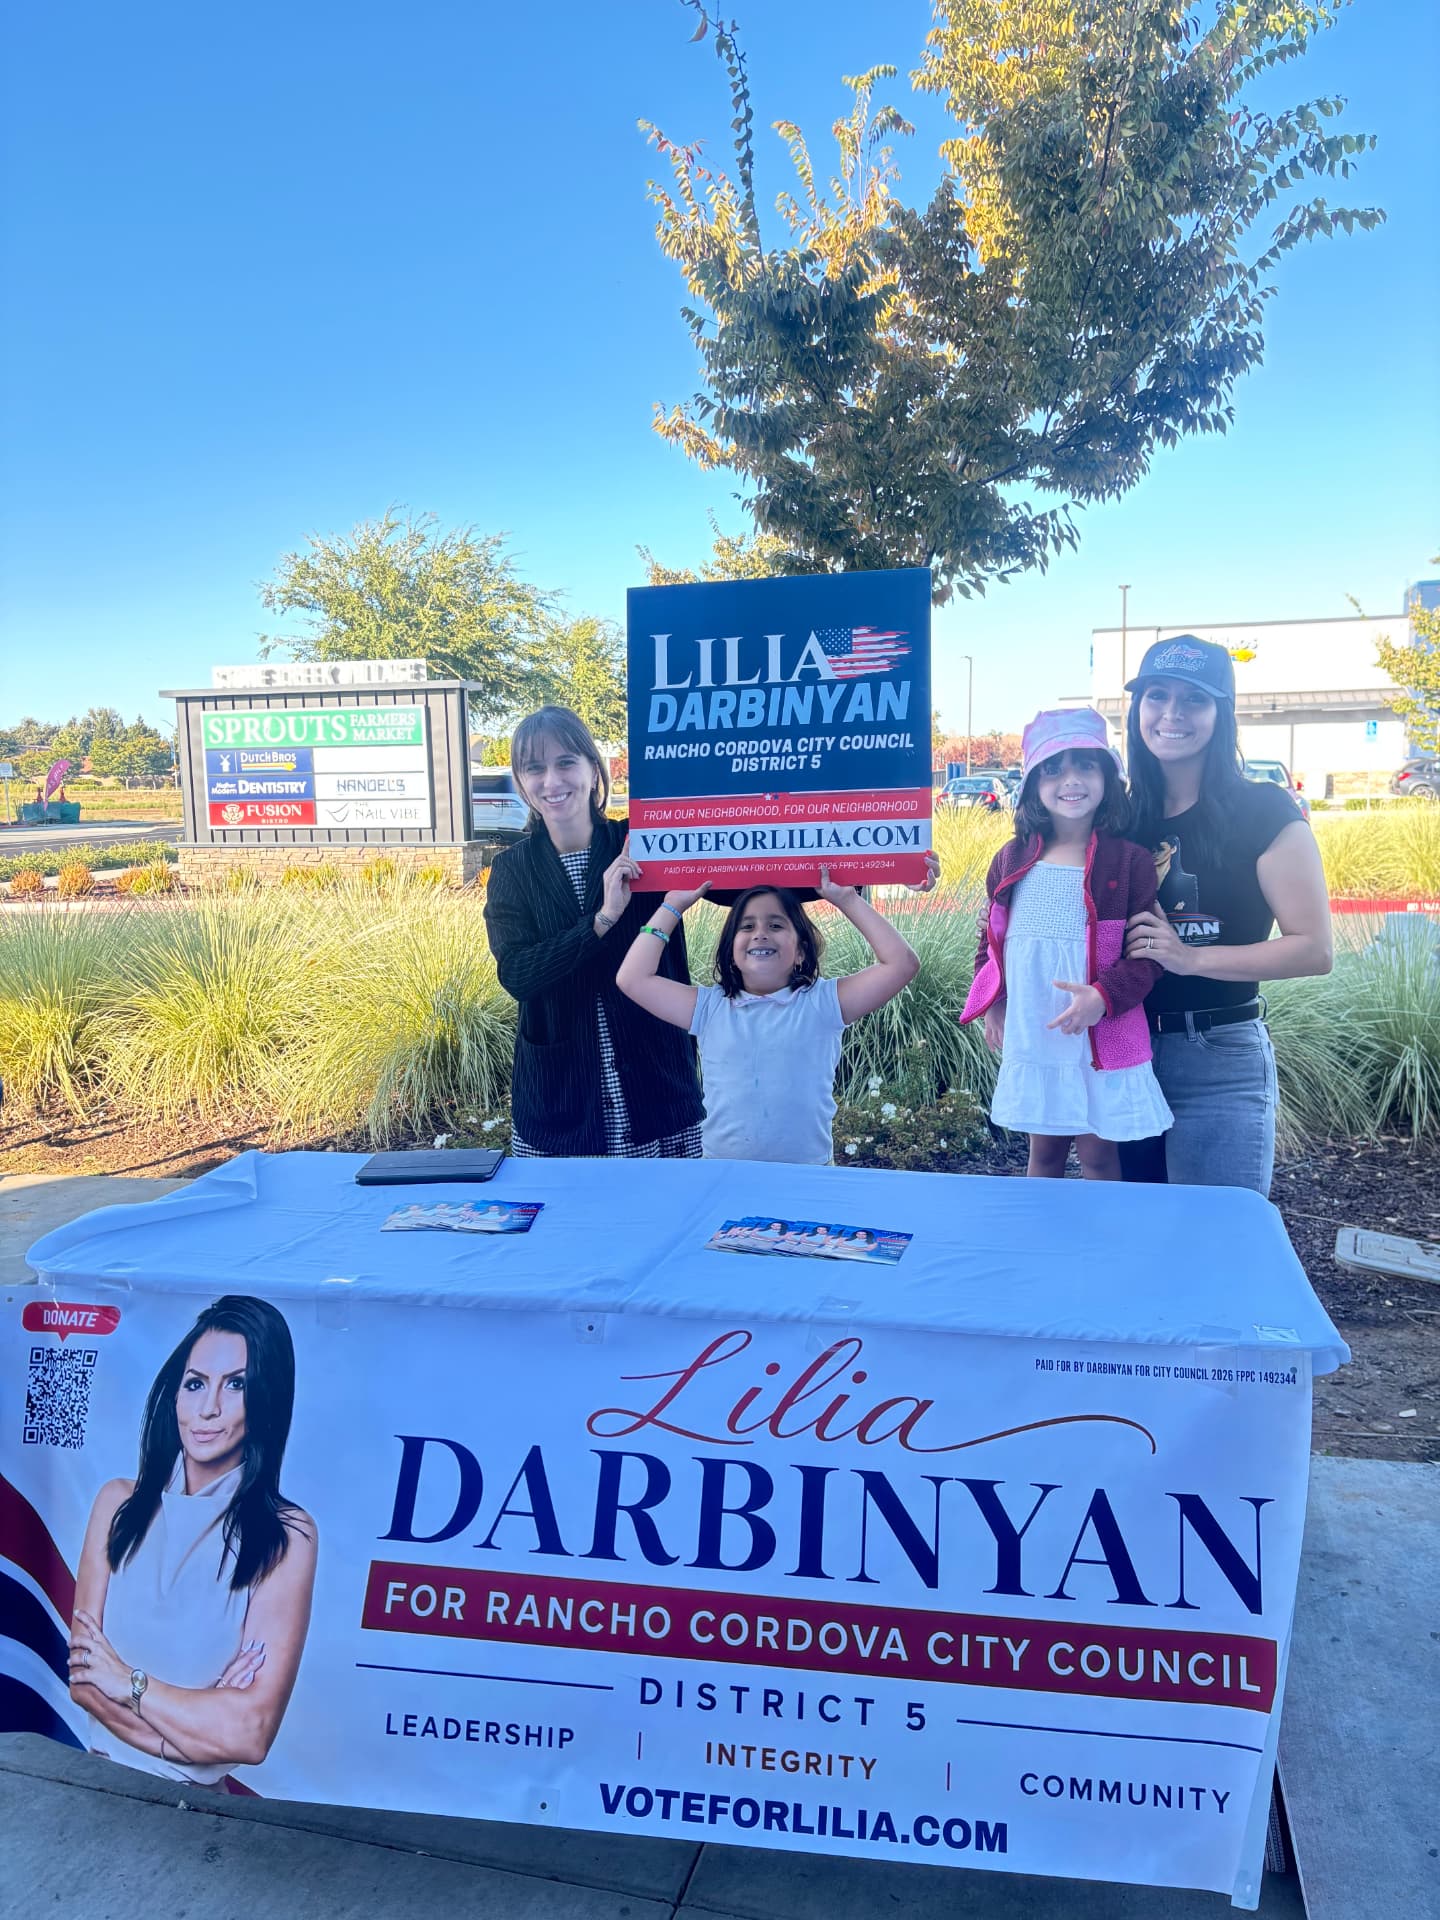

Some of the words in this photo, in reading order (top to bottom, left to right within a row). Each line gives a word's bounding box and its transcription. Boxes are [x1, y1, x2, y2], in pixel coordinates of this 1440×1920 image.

[649, 630, 836, 691] LILIA
[351, 713, 417, 728] FARMERS
[648, 681, 911, 733] DARBINYAN
[208, 714, 347, 745] SPROUTS
[353, 727, 416, 742] MARKET
[645, 742, 711, 760] RANCHO
[714, 738, 793, 757] CORDOVA
[797, 736, 836, 753] CITY
[840, 732, 914, 750] COUNCIL
[731, 754, 808, 773] DISTRICT
[810, 754, 822, 769] 5
[238, 779, 307, 795] DENTISTRY
[246, 804, 302, 817] FUSION
[355, 808, 387, 820] NAIL
[390, 808, 421, 820] VIBE
[643, 809, 672, 821] FROM
[674, 808, 695, 820] OUR
[697, 805, 781, 819] NEIGHBORHOOD,
[784, 804, 805, 815] FOR
[807, 803, 830, 814] OUR
[832, 800, 918, 813] NEIGHBORHOOD
[641, 825, 920, 855] VOTEFORLILIA.COM
[664, 866, 680, 875] PAID
[681, 865, 696, 874] FOR
[697, 865, 707, 874] BY
[707, 864, 749, 874] DARBINYAN
[750, 863, 765, 872] FOR
[766, 863, 782, 872] CITY
[784, 862, 815, 871] COUNCIL
[860, 860, 896, 870] 1492344
[43, 1309, 99, 1328] DONATE
[1035, 1359, 1054, 1371] PAID
[1056, 1360, 1071, 1372] FOR
[1074, 1361, 1084, 1373] BY
[1087, 1362, 1133, 1376] DARBINYAN
[1135, 1364, 1150, 1377] FOR
[1153, 1366, 1171, 1378] CITY
[1174, 1366, 1208, 1380] COUNCIL
[1211, 1368, 1233, 1381] 2026
[1236, 1370, 1256, 1382] FPPC
[1259, 1371, 1296, 1385] 1492344
[586, 1329, 1156, 1455] Lilia
[376, 1433, 1275, 1616] DARBINYAN
[384, 1581, 465, 1621] FOR
[485, 1591, 672, 1640] RANCHO
[689, 1610, 908, 1662] CORDOVA
[927, 1630, 1031, 1672] CITY
[1047, 1642, 1262, 1694] COUNCIL
[640, 1677, 875, 1727] DISTRICT
[905, 1702, 927, 1731] 5
[385, 1712, 575, 1750] LEADERSHIP
[706, 1741, 878, 1780] INTEGRITY
[1019, 1772, 1231, 1815] COMMUNITY
[599, 1783, 1009, 1854] VOTEFORLILIA.COM
